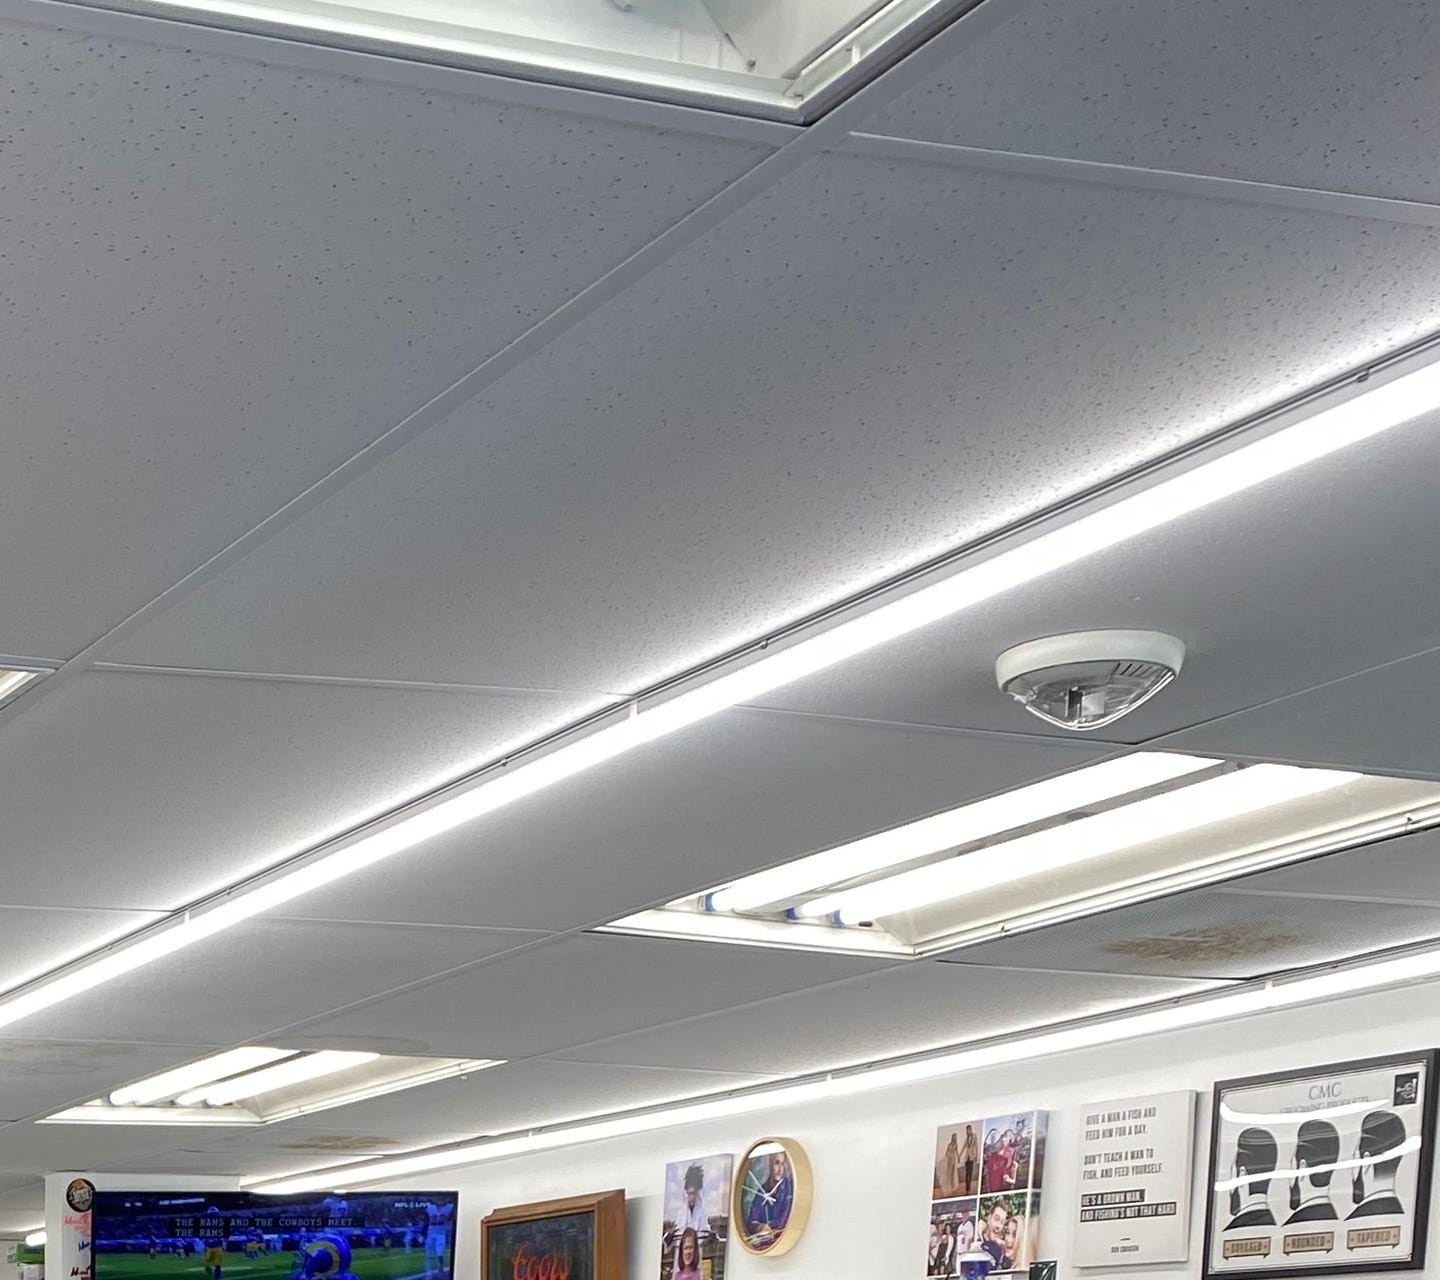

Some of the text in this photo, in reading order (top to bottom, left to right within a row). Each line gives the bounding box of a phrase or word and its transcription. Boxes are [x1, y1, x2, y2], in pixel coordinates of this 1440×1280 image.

[1308, 1082, 1342, 1100] CMC
[1144, 1107, 1156, 1117] AND
[175, 1218, 354, 1227] THE RAMS AND THE COWBOYS MEET
[175, 1229, 225, 1237] THE RAMS
[1291, 1236, 1325, 1249] ROUNDED
